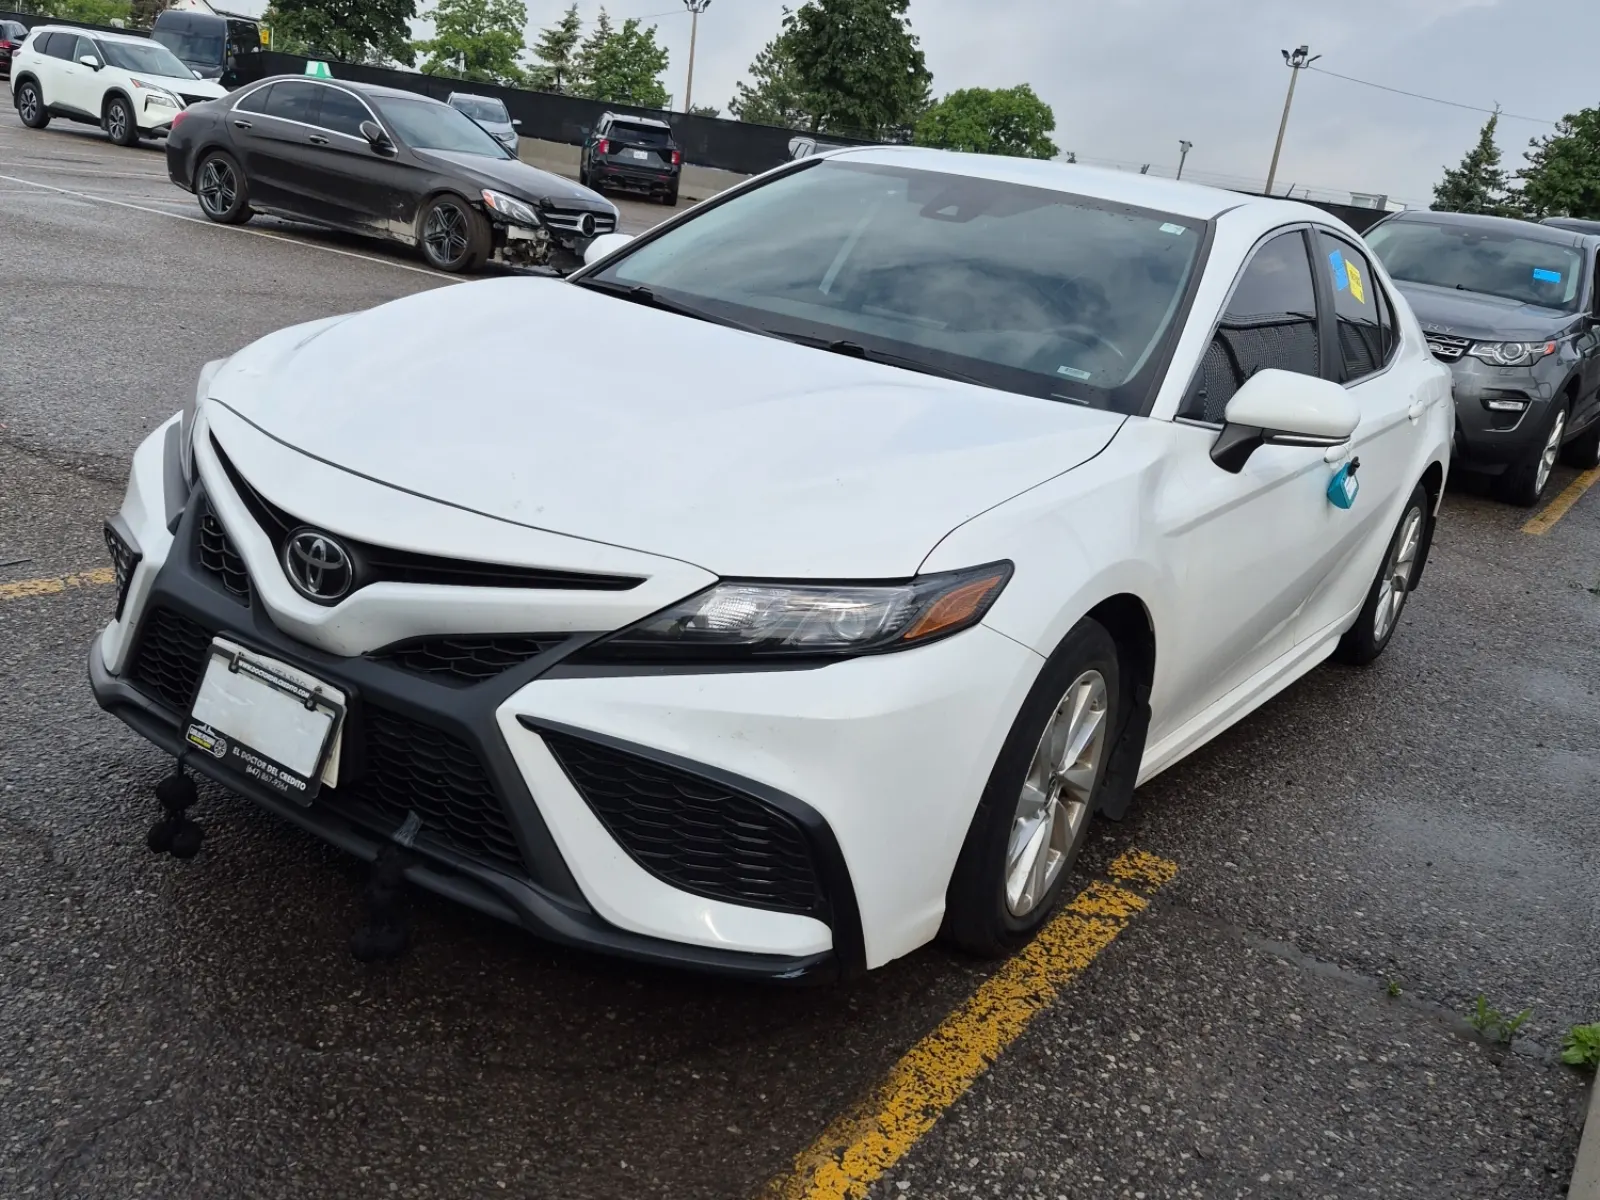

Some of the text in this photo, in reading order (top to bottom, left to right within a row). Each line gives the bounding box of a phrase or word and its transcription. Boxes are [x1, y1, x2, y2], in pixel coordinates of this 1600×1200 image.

[232, 746, 306, 791] EL DOCTOR DEL CREDITO
